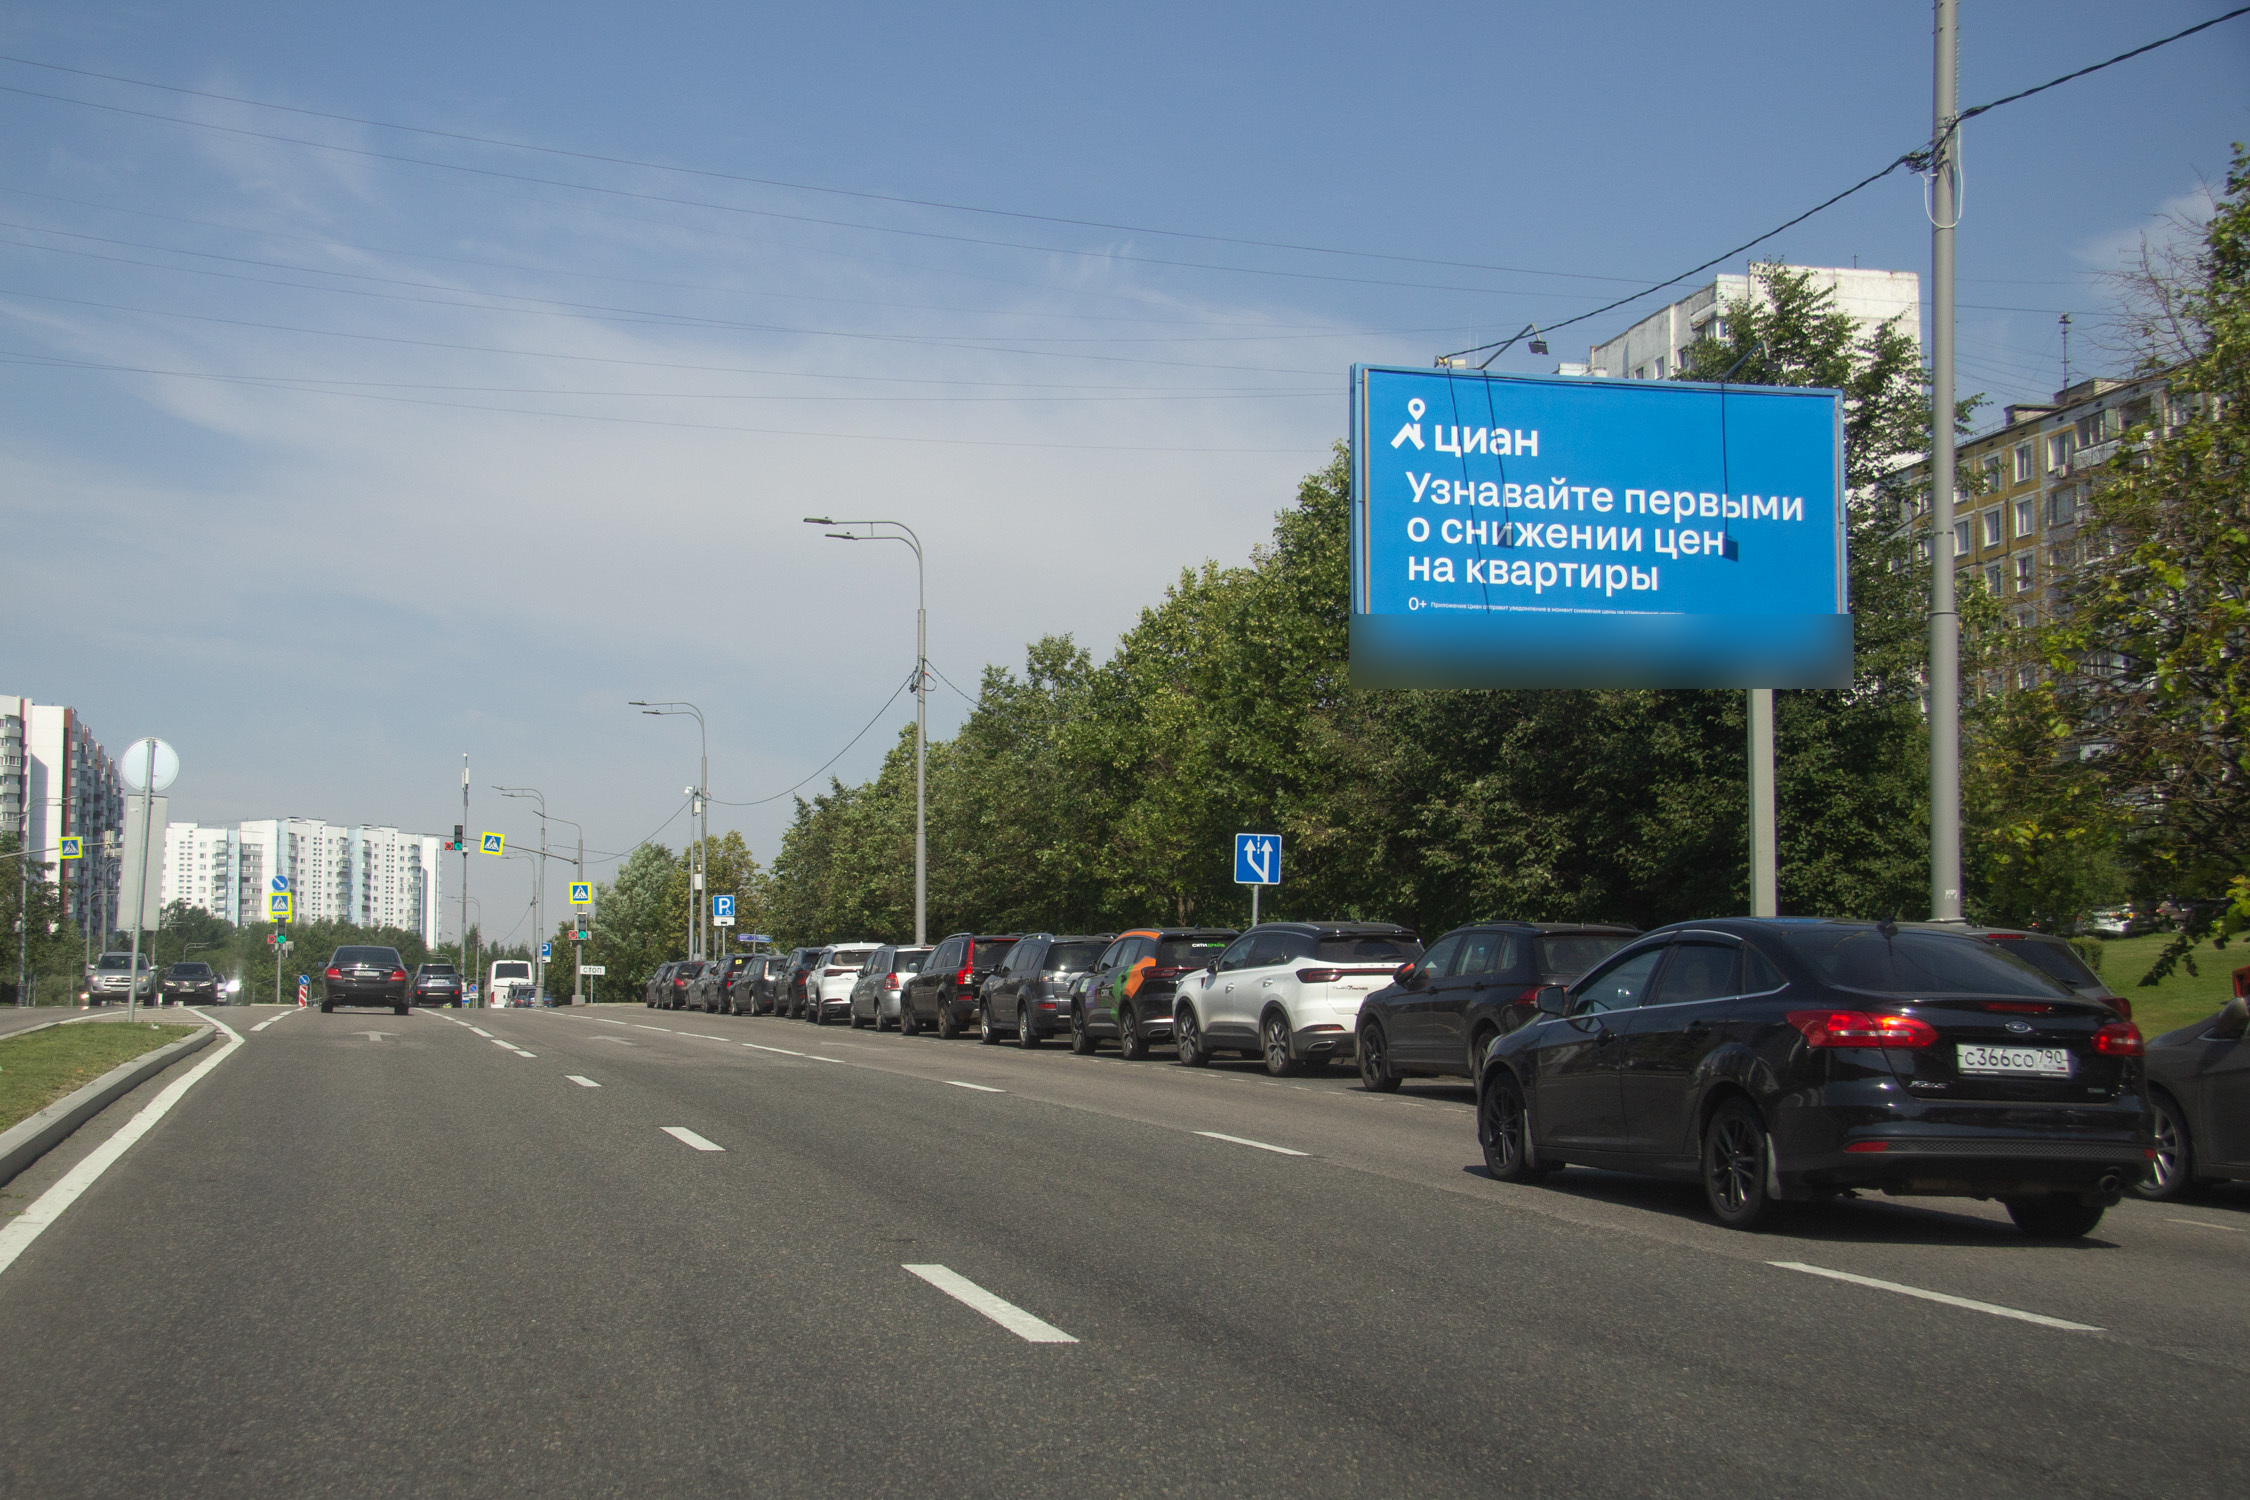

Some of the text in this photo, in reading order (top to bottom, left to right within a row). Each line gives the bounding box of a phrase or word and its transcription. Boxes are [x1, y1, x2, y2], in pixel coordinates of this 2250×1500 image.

[1435, 425, 1538, 457] циан
[1406, 471, 1803, 523] Узнавайте первыми
[1407, 517, 1724, 559] о снижении цен
[1409, 556, 1658, 597] на квартиры
[1408, 597, 1427, 611] 0+
[719, 898, 731, 914] P
